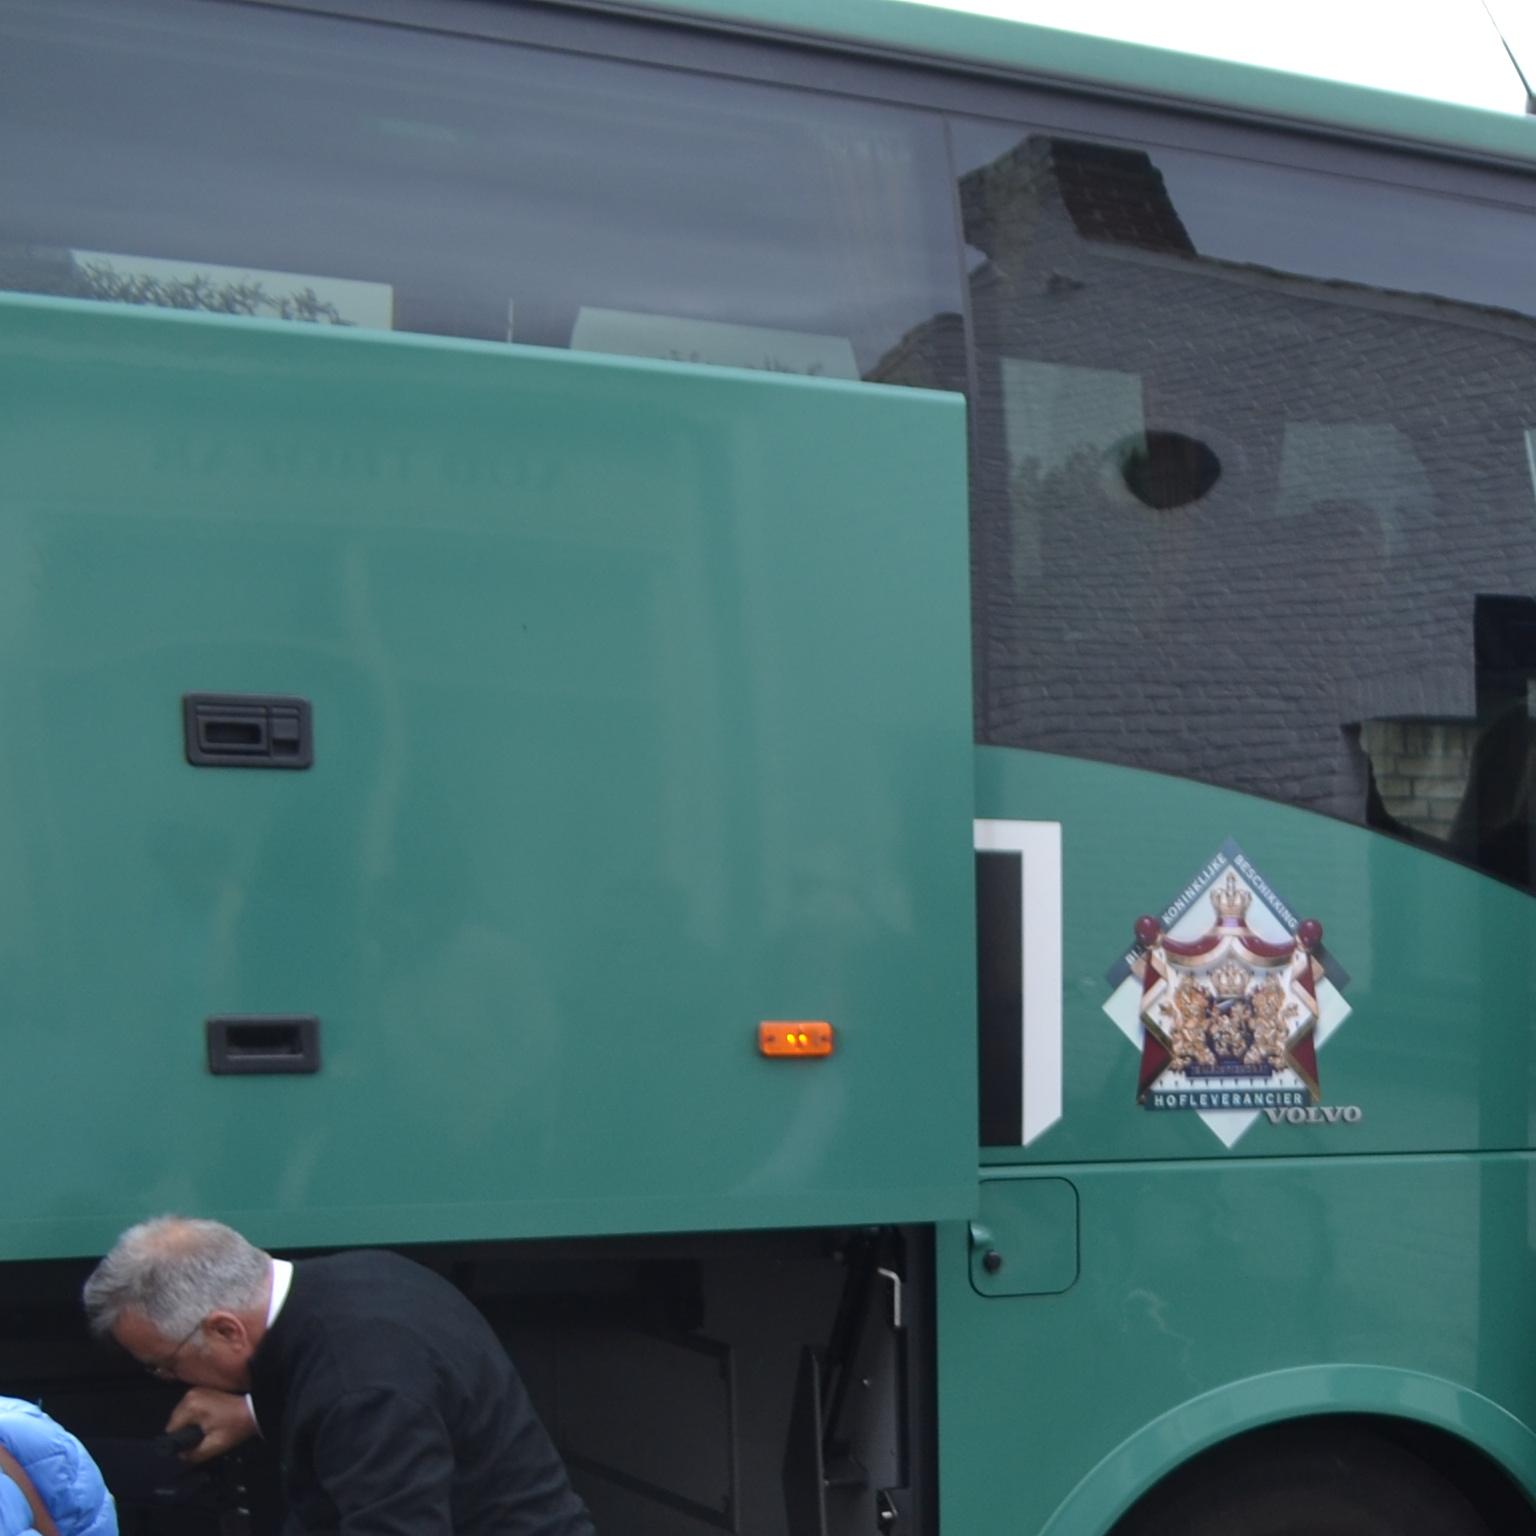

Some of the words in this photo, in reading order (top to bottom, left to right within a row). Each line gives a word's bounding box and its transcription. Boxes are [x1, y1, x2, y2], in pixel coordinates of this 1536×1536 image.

[1161, 852, 1226, 925] KONINKLIJKE
[1234, 854, 1298, 929] BESCHIKKING
[1153, 1092, 1304, 1107] HOFLEVERANCIER
[1264, 1106, 1362, 1125] VOLVO
